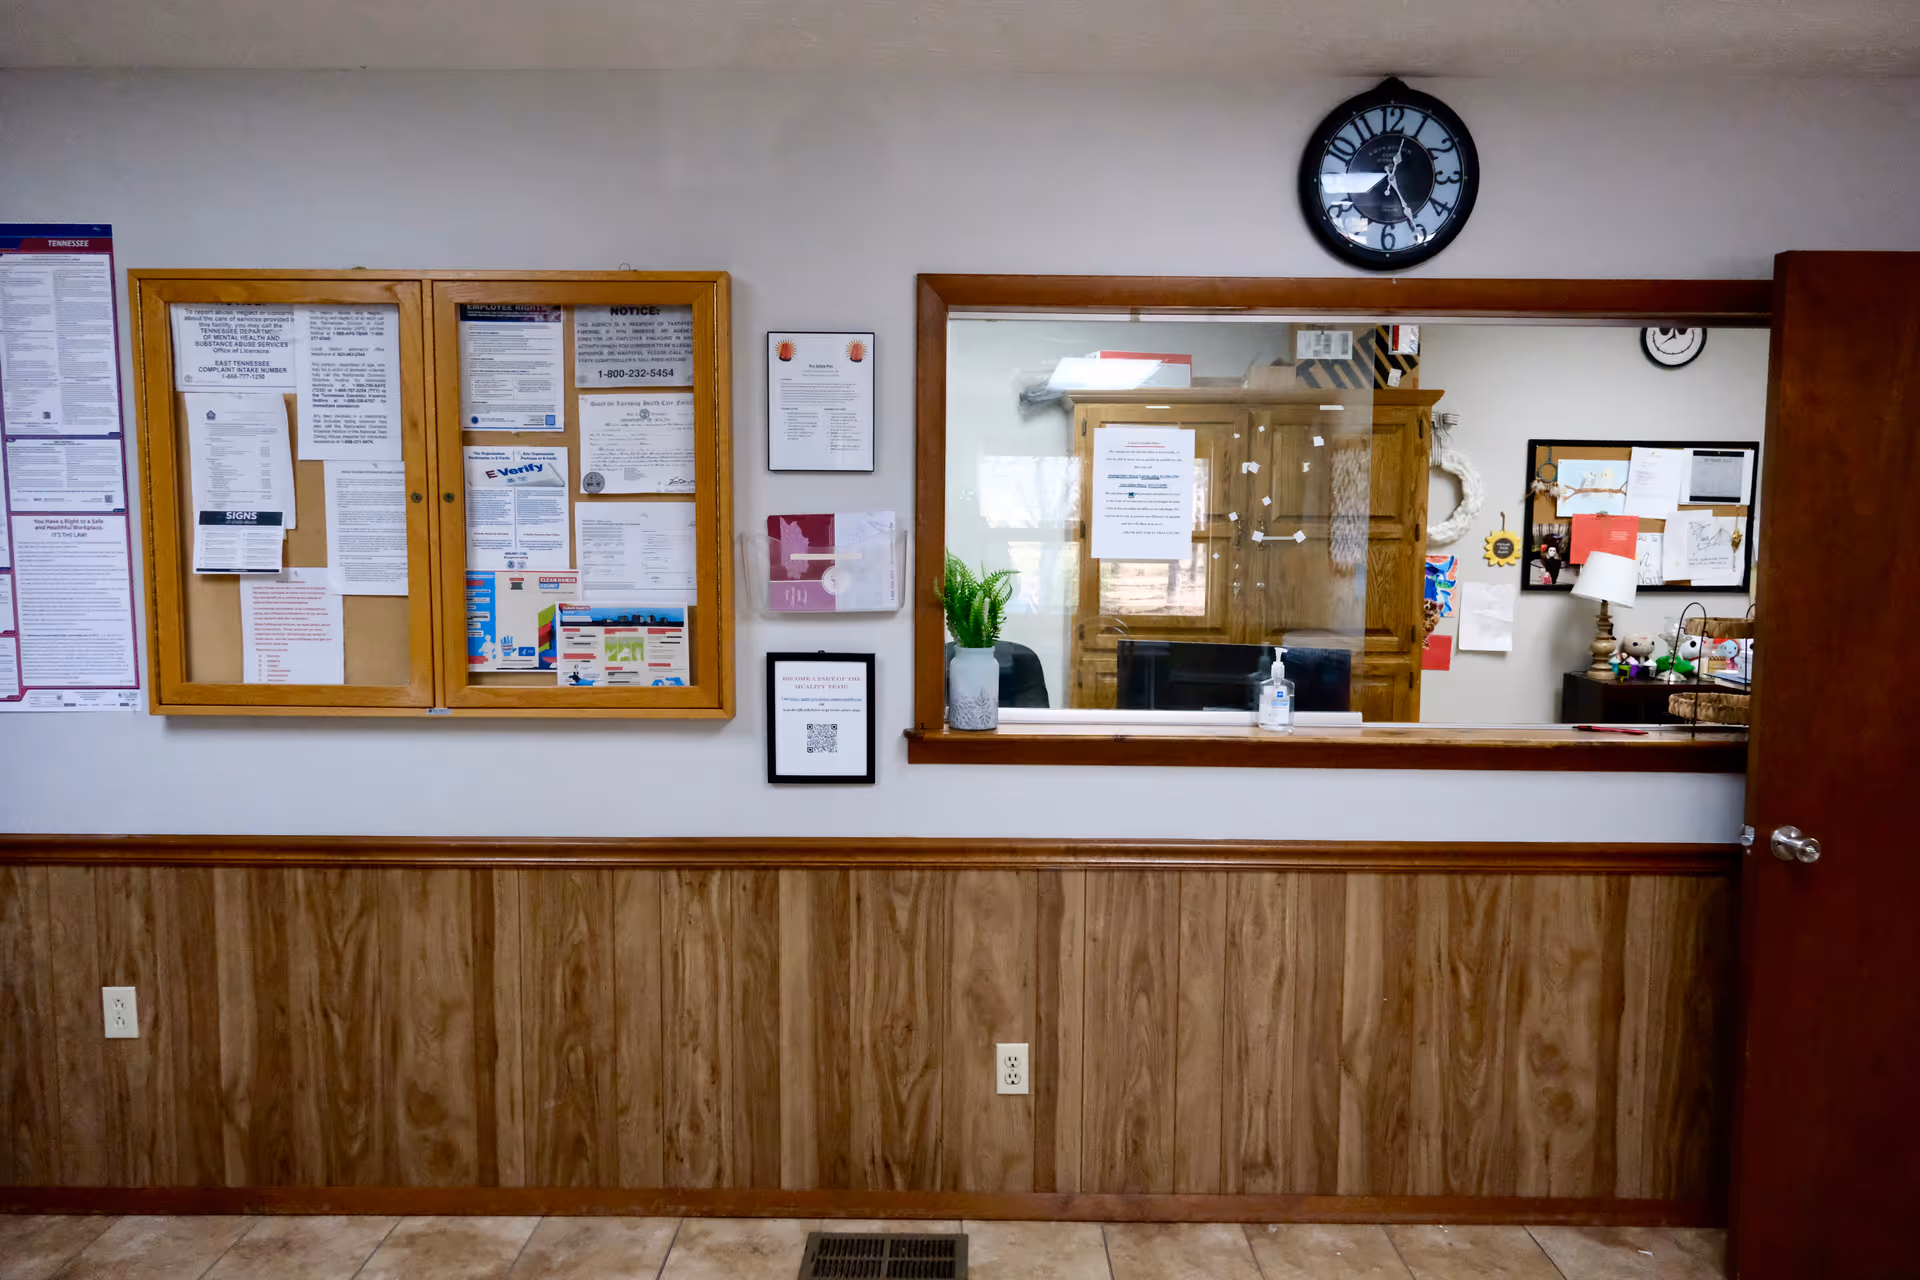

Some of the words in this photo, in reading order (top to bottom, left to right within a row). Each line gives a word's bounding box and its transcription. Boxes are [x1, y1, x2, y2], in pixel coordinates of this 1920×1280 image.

[1352, 113, 1379, 146] 11
[1381, 107, 1405, 134] 12
[1413, 114, 1430, 141] 1
[1327, 136, 1357, 166] 10
[1427, 137, 1455, 161] 2
[1435, 170, 1462, 185] 3
[1430, 197, 1451, 217] 4
[1381, 224, 1396, 250] 6
[610, 306, 660, 316] NOTICE:
[598, 369, 674, 378] 1-800-232-5454
[226, 511, 257, 520] SIGNS
